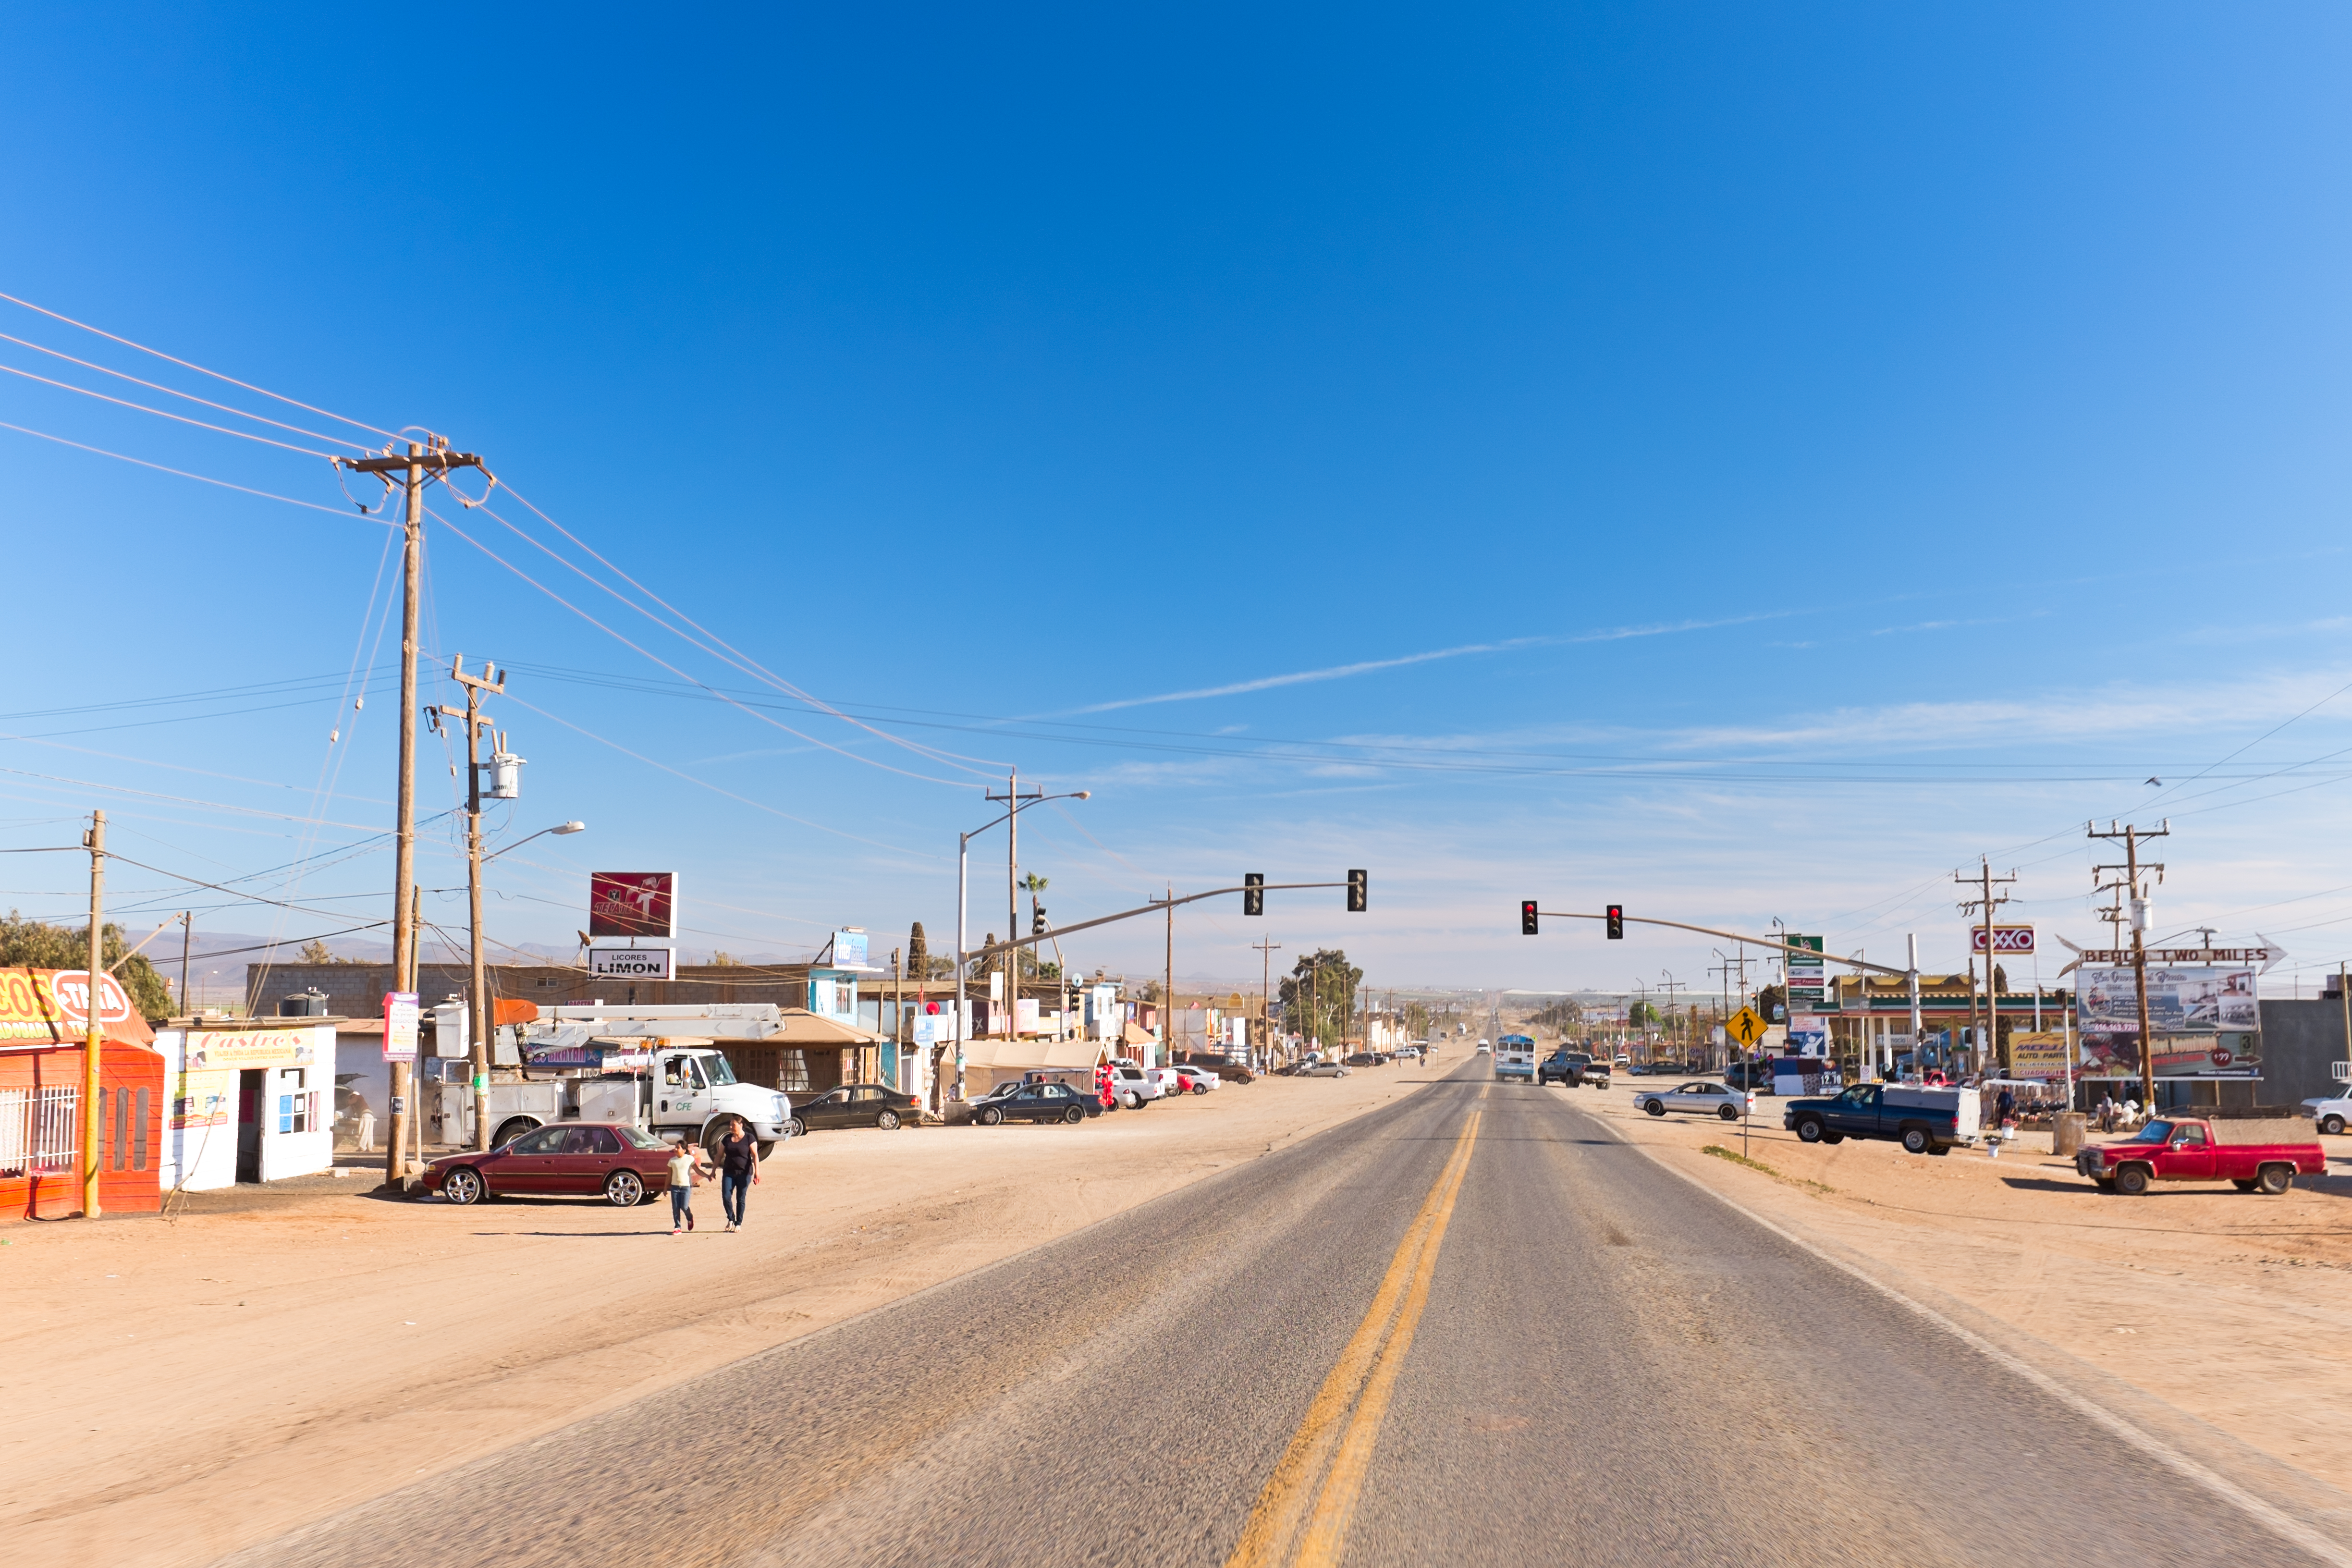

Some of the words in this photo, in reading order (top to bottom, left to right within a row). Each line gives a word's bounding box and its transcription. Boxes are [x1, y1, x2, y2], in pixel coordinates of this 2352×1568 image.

[594, 902, 635, 914] TECATE
[1974, 929, 2033, 949] OXXO
[2157, 949, 2199, 961] TWO
[2213, 948, 2268, 961] MILES
[597, 963, 661, 973] LIMON
[66, 1020, 107, 1038] TRA
[200, 1030, 302, 1049] Castro's
[2242, 1035, 2251, 1049] 3
[676, 1102, 692, 1111] CFE
